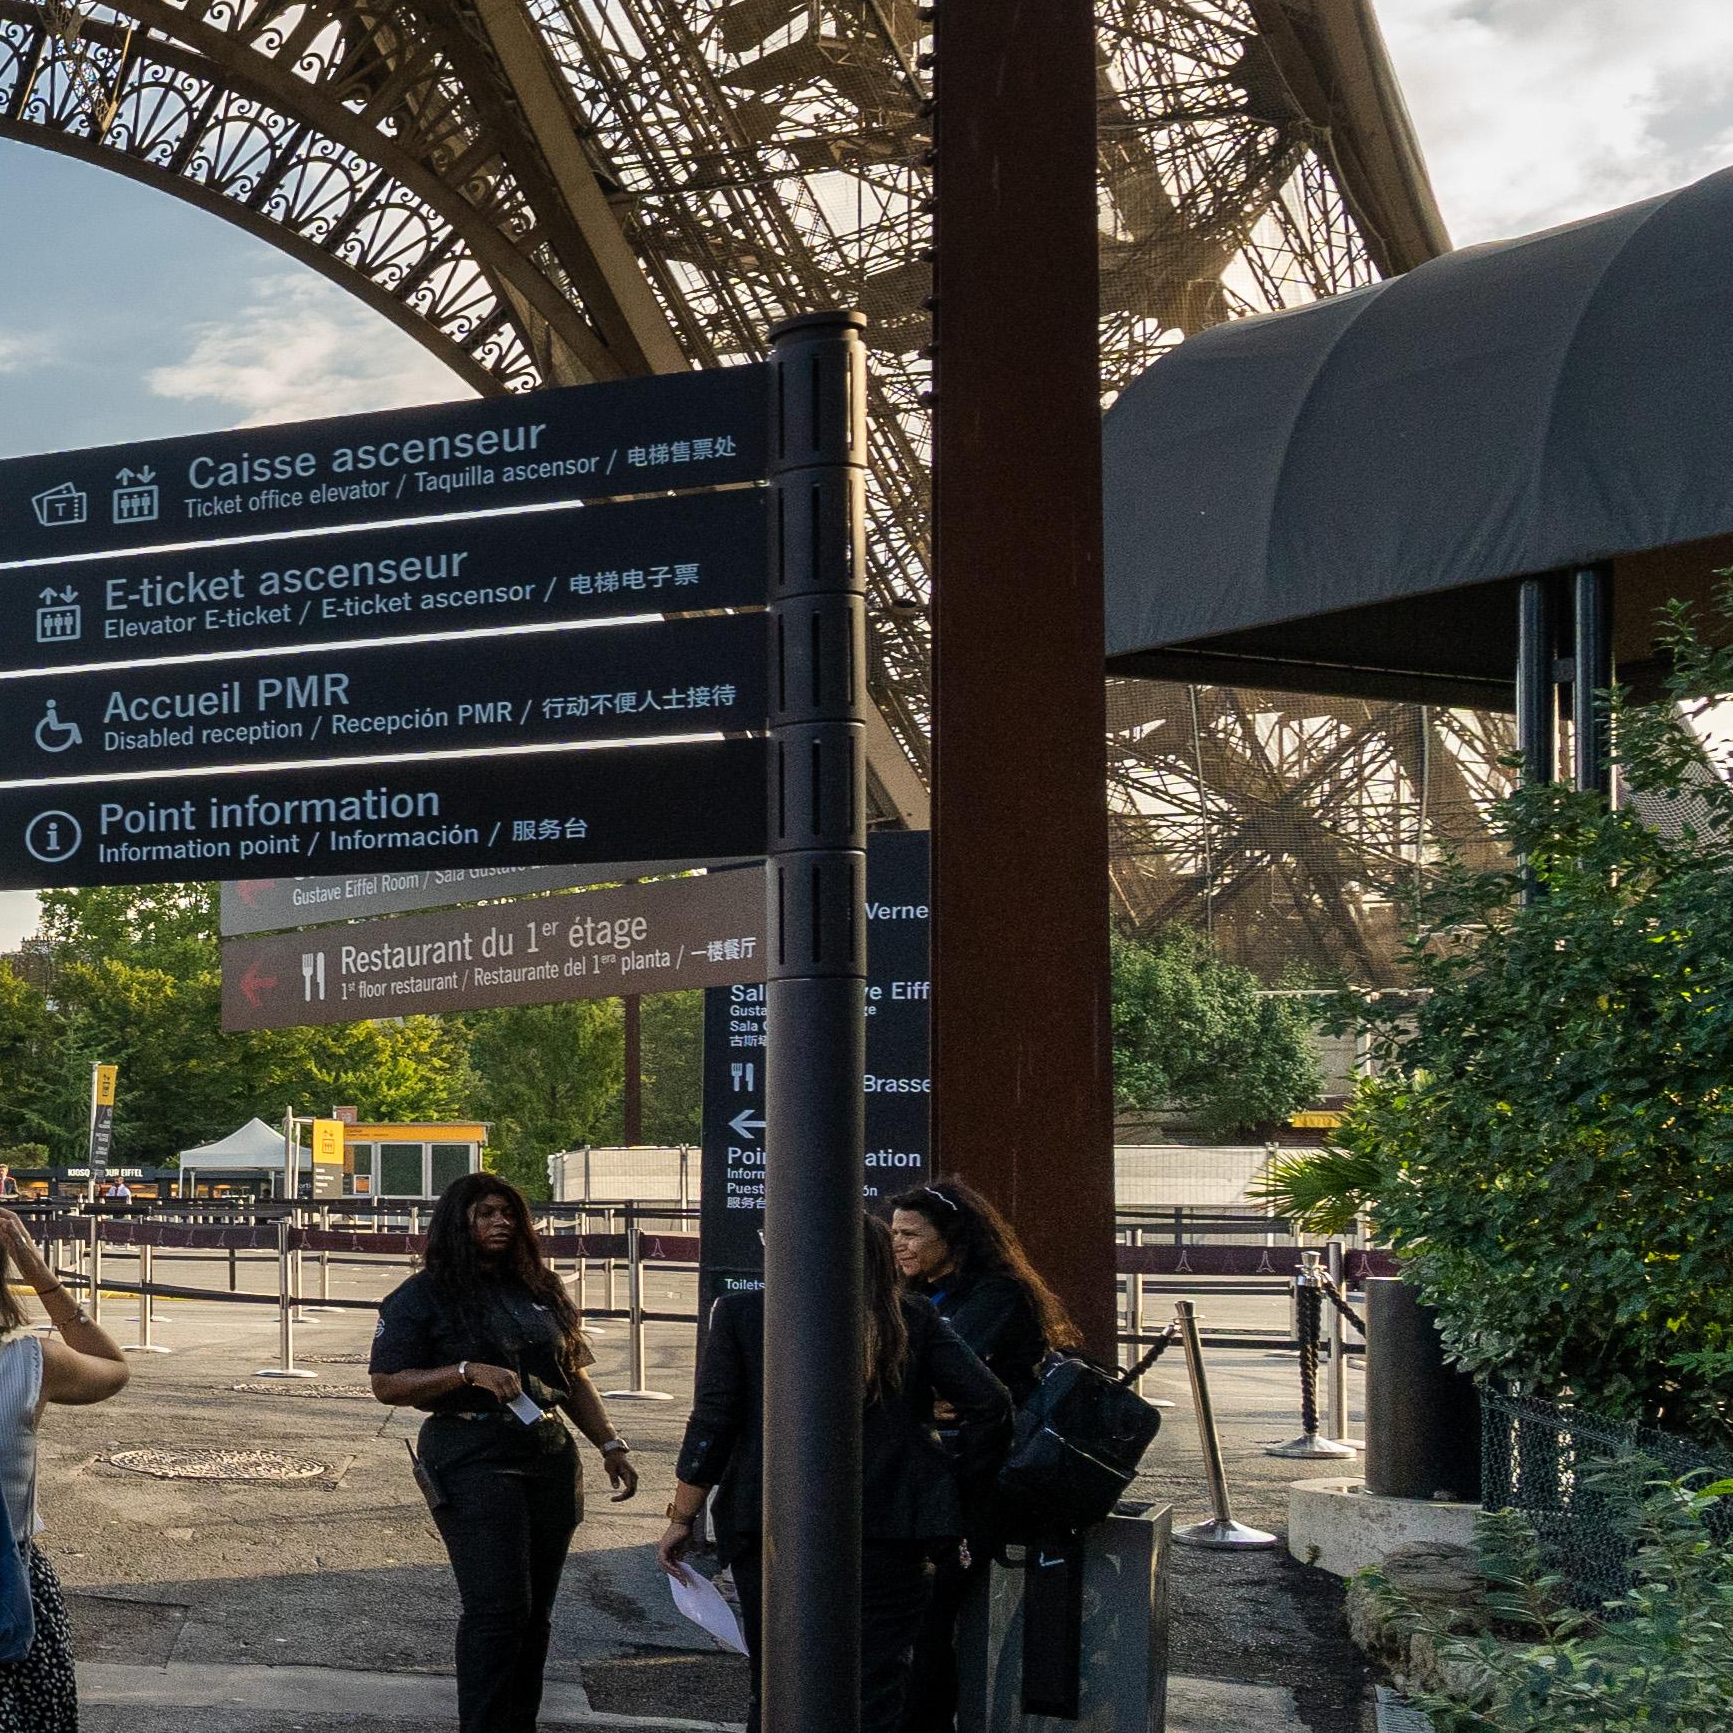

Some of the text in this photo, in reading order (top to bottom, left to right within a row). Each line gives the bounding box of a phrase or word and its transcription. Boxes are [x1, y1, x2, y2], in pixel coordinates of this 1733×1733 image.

[184, 497, 242, 519] Ticket
[248, 490, 303, 513] office
[309, 481, 389, 506] elevator
[414, 465, 495, 493] Taquilla
[502, 456, 600, 482] ascensor
[627, 435, 737, 467] 电梯售票处
[188, 423, 546, 490] Caisse ascenseur
[104, 614, 196, 639] Elevator
[205, 603, 291, 630] E-ticket
[322, 592, 412, 618] E-ticket
[420, 584, 535, 609] ascensor
[569, 563, 700, 595] 电梯电子票
[105, 551, 468, 611] E-ticket ascenseur
[103, 673, 350, 723] Accueil PMR
[104, 726, 194, 751] Disabled
[202, 719, 303, 744] reception
[332, 707, 448, 736] Recepción
[457, 701, 513, 725] PMR
[542, 683, 736, 718] 行动不便人士接待
[101, 787, 439, 835] Point information
[99, 838, 230, 863] Information
[240, 834, 300, 860] point
[330, 824, 479, 851] Información
[512, 817, 588, 841] 服务台
[293, 885, 341, 906] Gustave
[345, 876, 377, 898] Eiffel
[381, 873, 419, 892] Room
[435, 869, 465, 885] Sala
[864, 902, 929, 920] Verne
[341, 915, 648, 975] Restaurant du 1er étage
[341, 980, 356, 1001] 1st
[358, 979, 385, 999] floor
[391, 972, 458, 995] restaurant
[474, 962, 560, 986] Restaurante
[564, 957, 586, 977] del
[621, 948, 671, 975] planta
[691, 936, 757, 962] 一楼餐厅
[730, 1020, 758, 1032] Sala
[121, 1168, 143, 1178] EIFFEL
